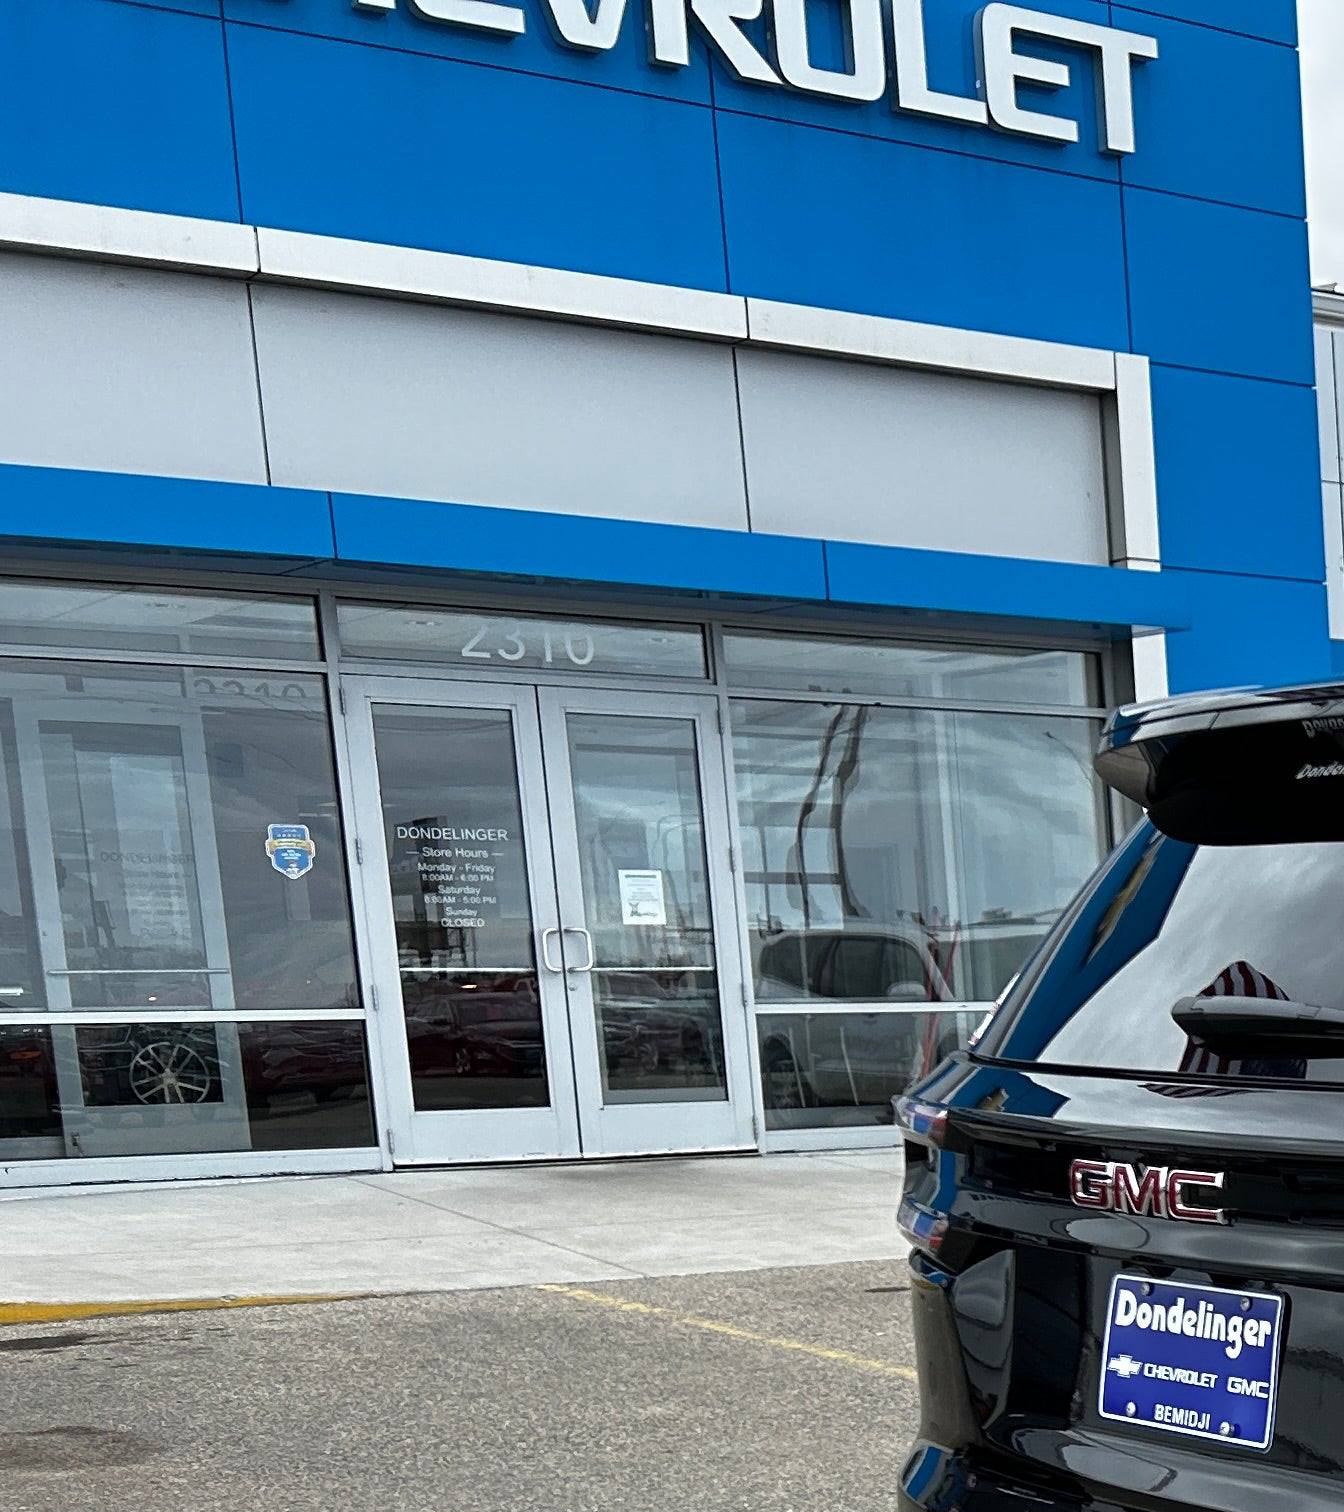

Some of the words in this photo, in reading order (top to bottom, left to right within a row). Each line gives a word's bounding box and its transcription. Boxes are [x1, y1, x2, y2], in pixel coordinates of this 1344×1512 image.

[350, 0, 1158, 156] ROLET
[461, 617, 594, 666] 2310
[396, 826, 510, 841] DONDELINGER
[422, 846, 453, 858] Store
[455, 847, 489, 858] Hours
[417, 862, 457, 873] Monday
[465, 862, 496, 874] Friday
[437, 884, 481, 896] Saturday
[445, 906, 478, 917] Sunday
[441, 917, 486, 928] CLOSED
[1069, 1158, 1226, 1226] GMC
[1114, 1289, 1272, 1359] Dondelinger
[1143, 1363, 1219, 1389] CHEVROLET
[1226, 1376, 1270, 1399] GMC
[1154, 1403, 1211, 1430] BEMIDJI
